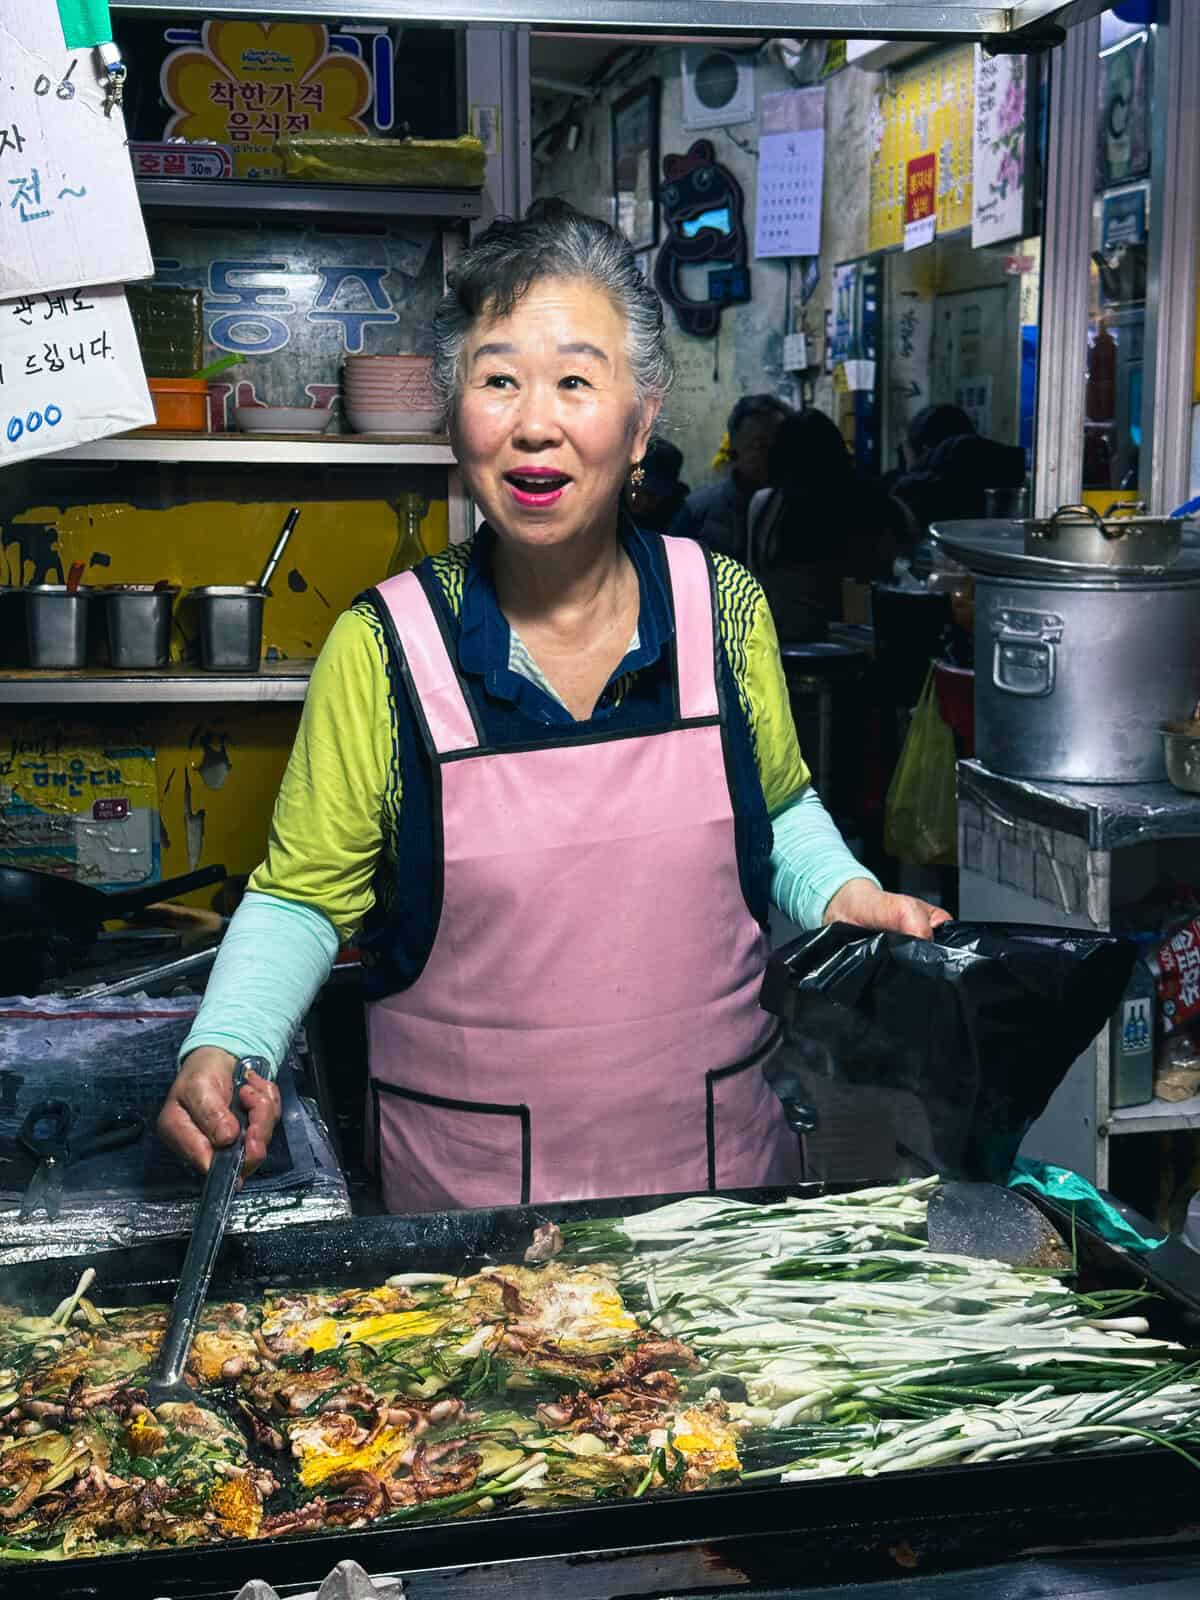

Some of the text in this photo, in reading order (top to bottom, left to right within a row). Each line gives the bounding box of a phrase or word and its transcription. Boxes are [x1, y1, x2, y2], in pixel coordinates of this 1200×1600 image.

[210, 82, 323, 112] 착한가격
[138, 154, 186, 175] 호일
[191, 163, 212, 176] 30m
